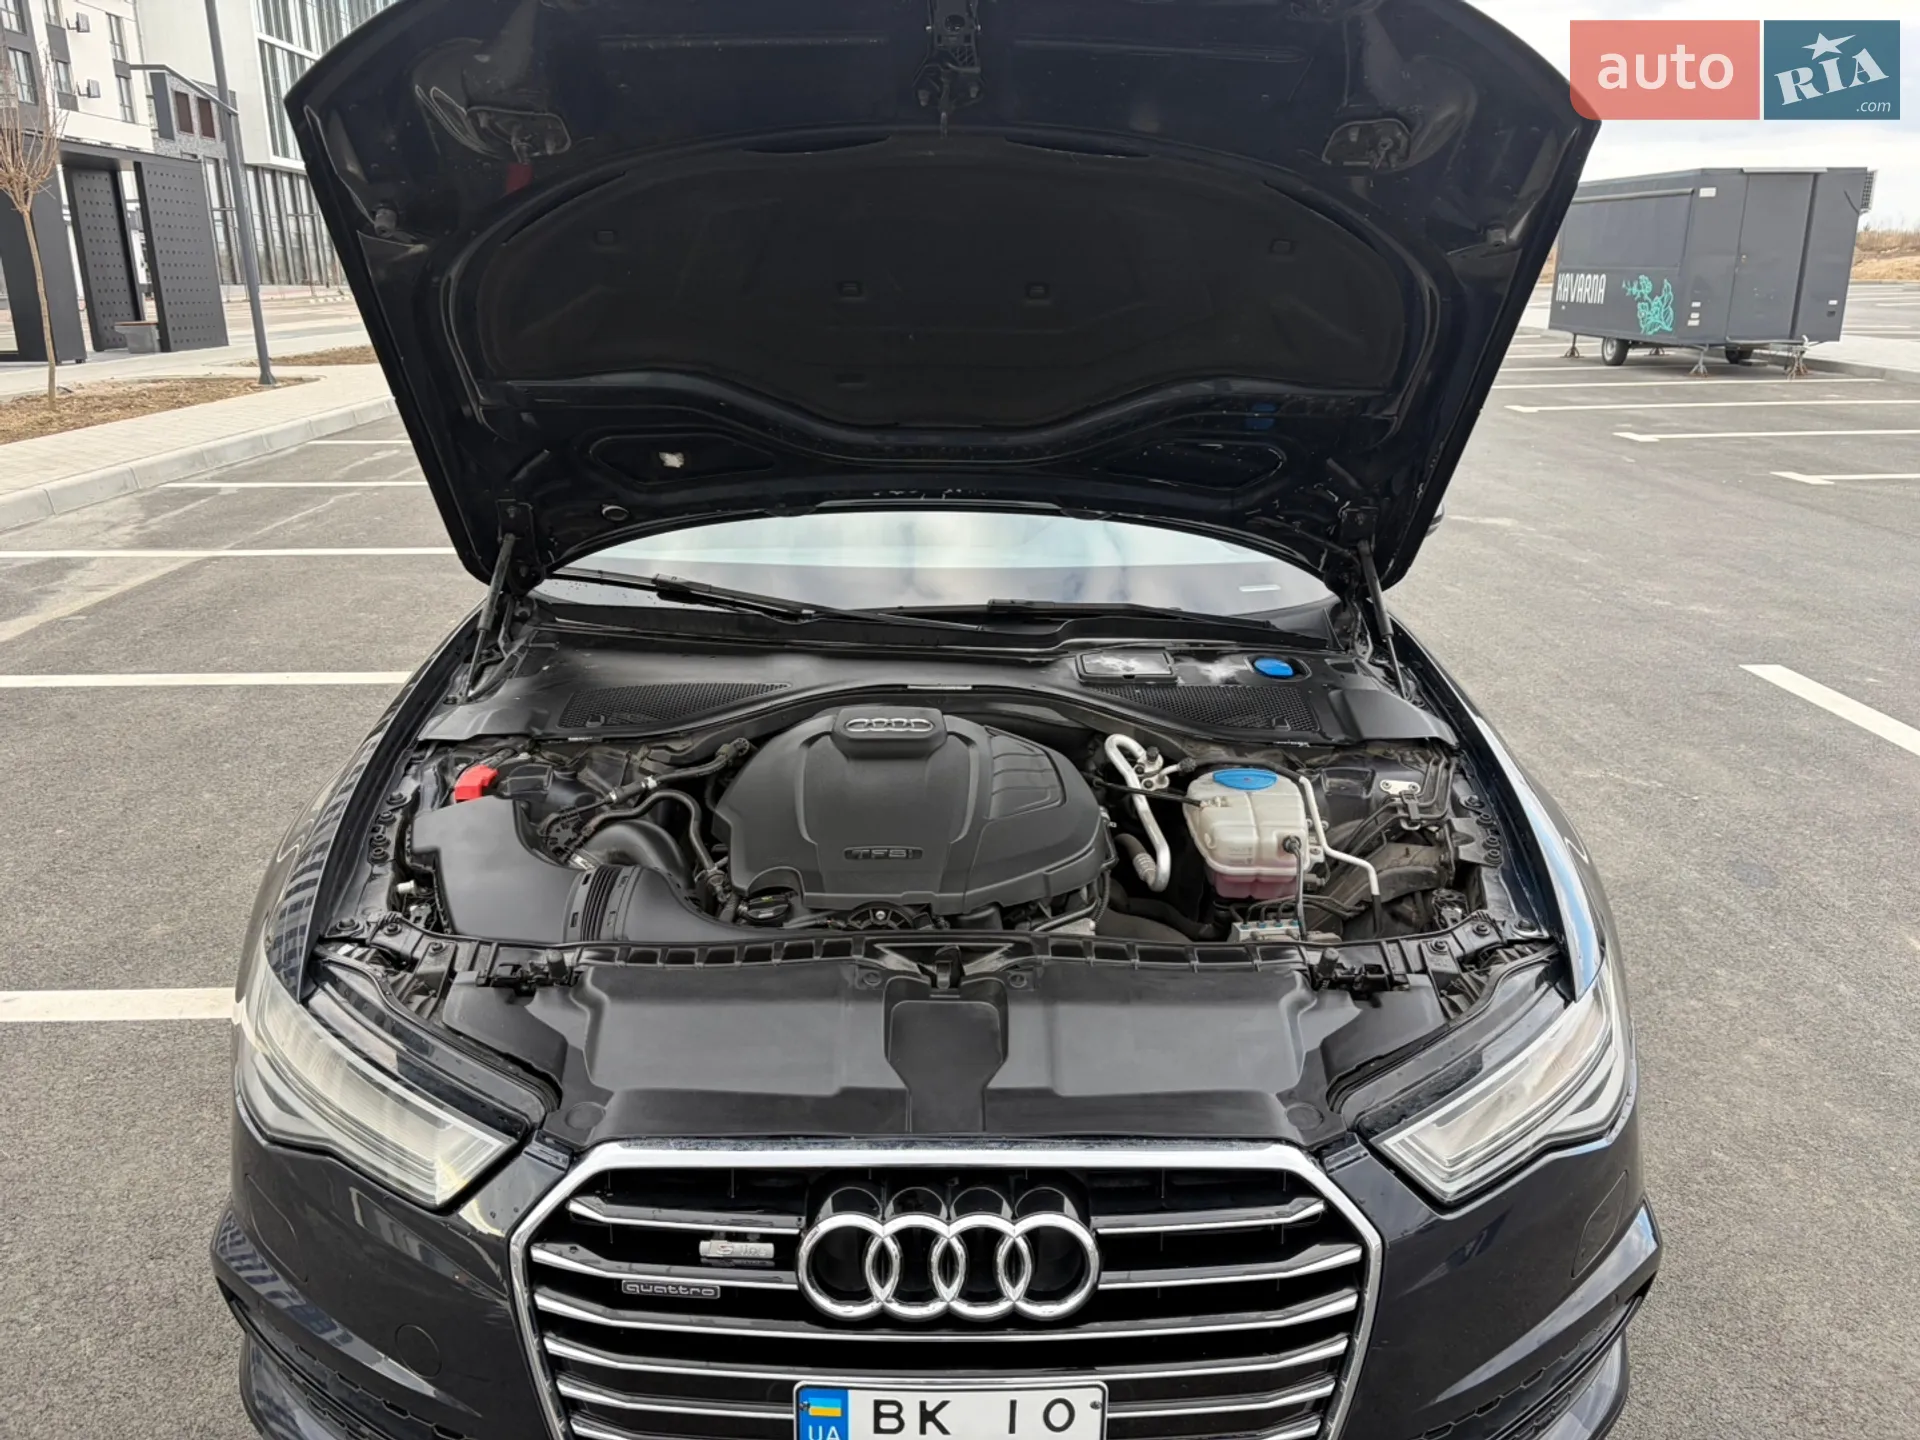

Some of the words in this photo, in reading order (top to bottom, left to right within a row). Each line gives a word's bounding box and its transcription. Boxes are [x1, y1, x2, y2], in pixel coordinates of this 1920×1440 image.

[1556, 273, 1607, 304] KAVARNA
[626, 1283, 716, 1297] quattro
[873, 1399, 951, 1436] BK
[808, 1424, 842, 1440] UA
